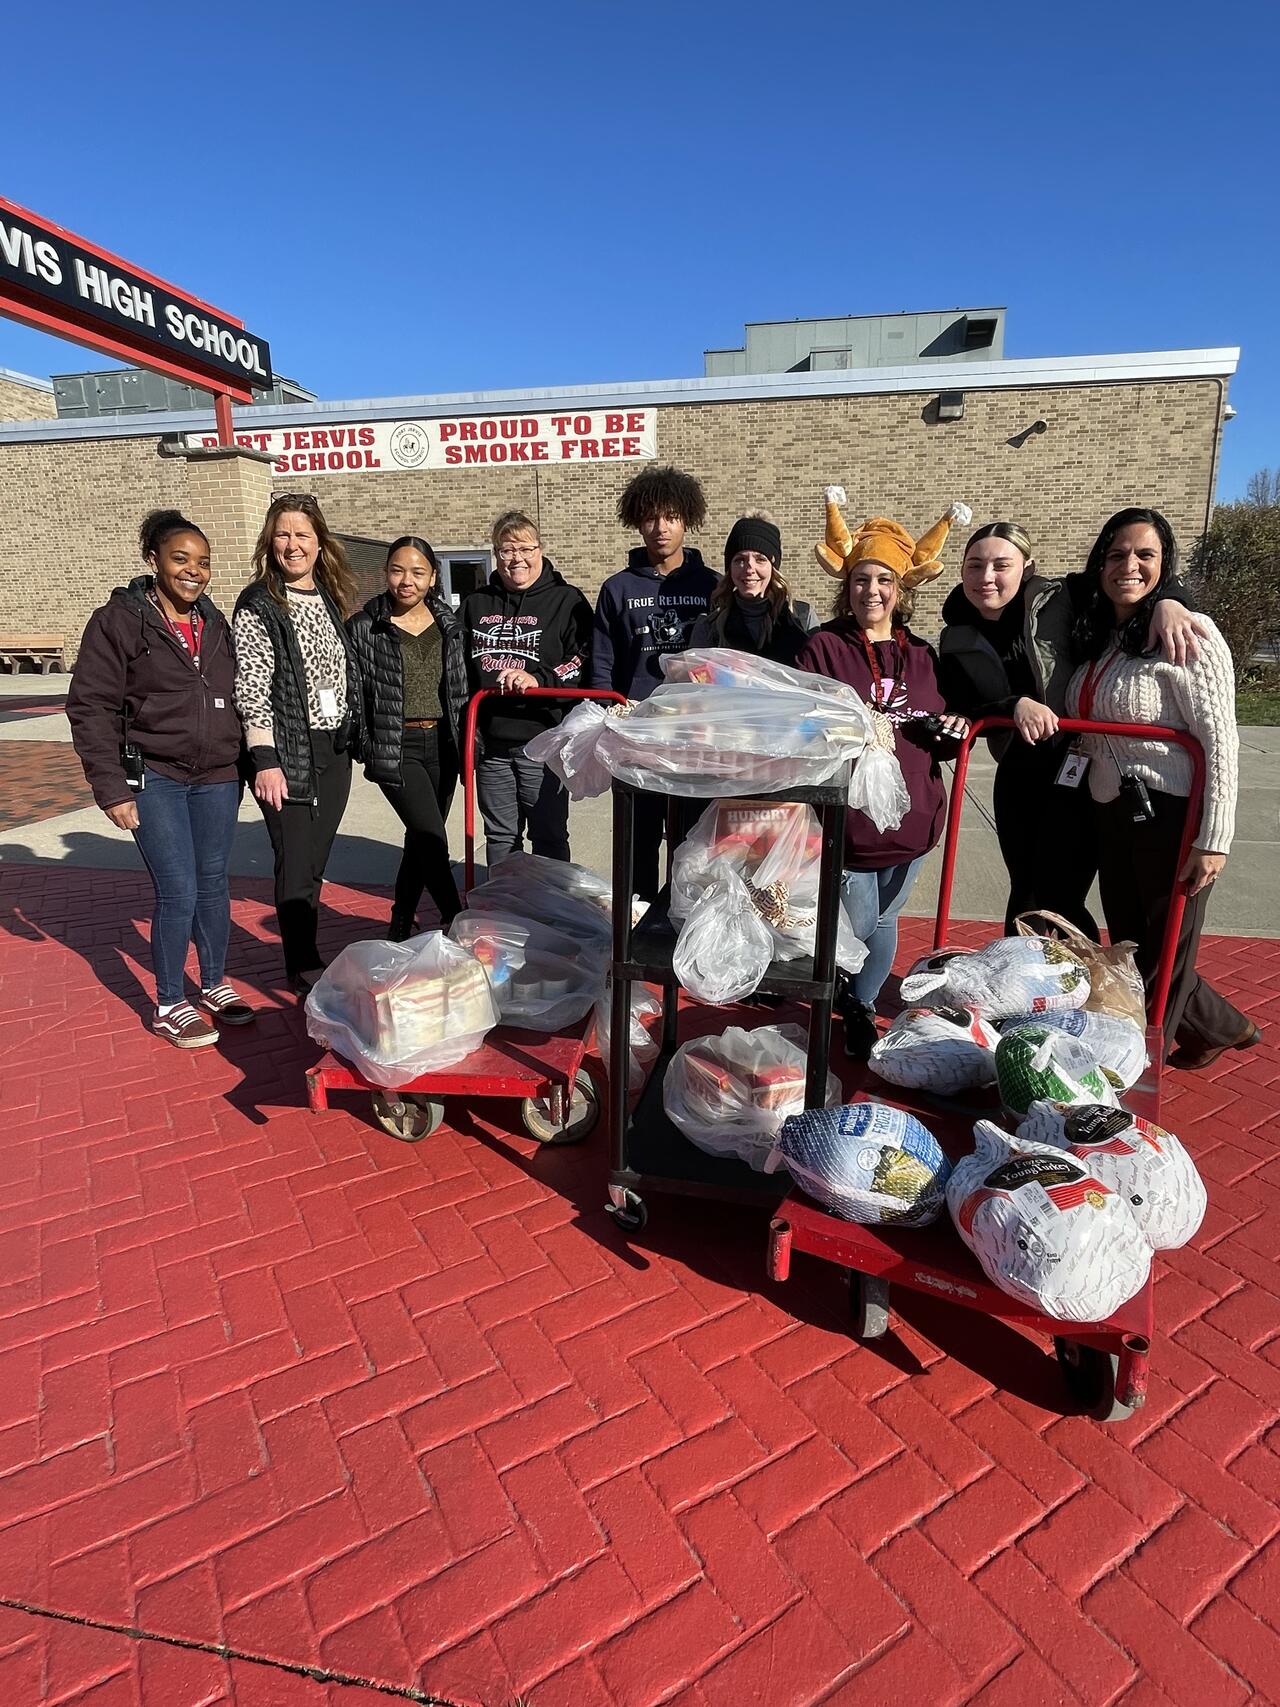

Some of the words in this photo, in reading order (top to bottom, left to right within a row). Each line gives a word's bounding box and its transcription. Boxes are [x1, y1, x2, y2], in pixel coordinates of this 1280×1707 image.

[74, 258, 156, 328] HIGH
[164, 304, 267, 377] SCHOOL
[440, 418, 539, 441] PROUD
[551, 415, 592, 436] TO
[605, 412, 645, 433] BE
[202, 434, 272, 452] PRT
[283, 427, 376, 451] JERVIS
[445, 441, 549, 465] SMOKE
[561, 437, 641, 459] FREE
[275, 450, 380, 473] SCHOOL
[627, 597, 655, 610] TRUE
[658, 595, 707, 607] RELIGION
[481, 654, 526, 673] Raiders
[728, 809, 790, 821] HUNGRY
[1001, 1166, 1038, 1182] Young
[1034, 1162, 1071, 1173] Turkey
